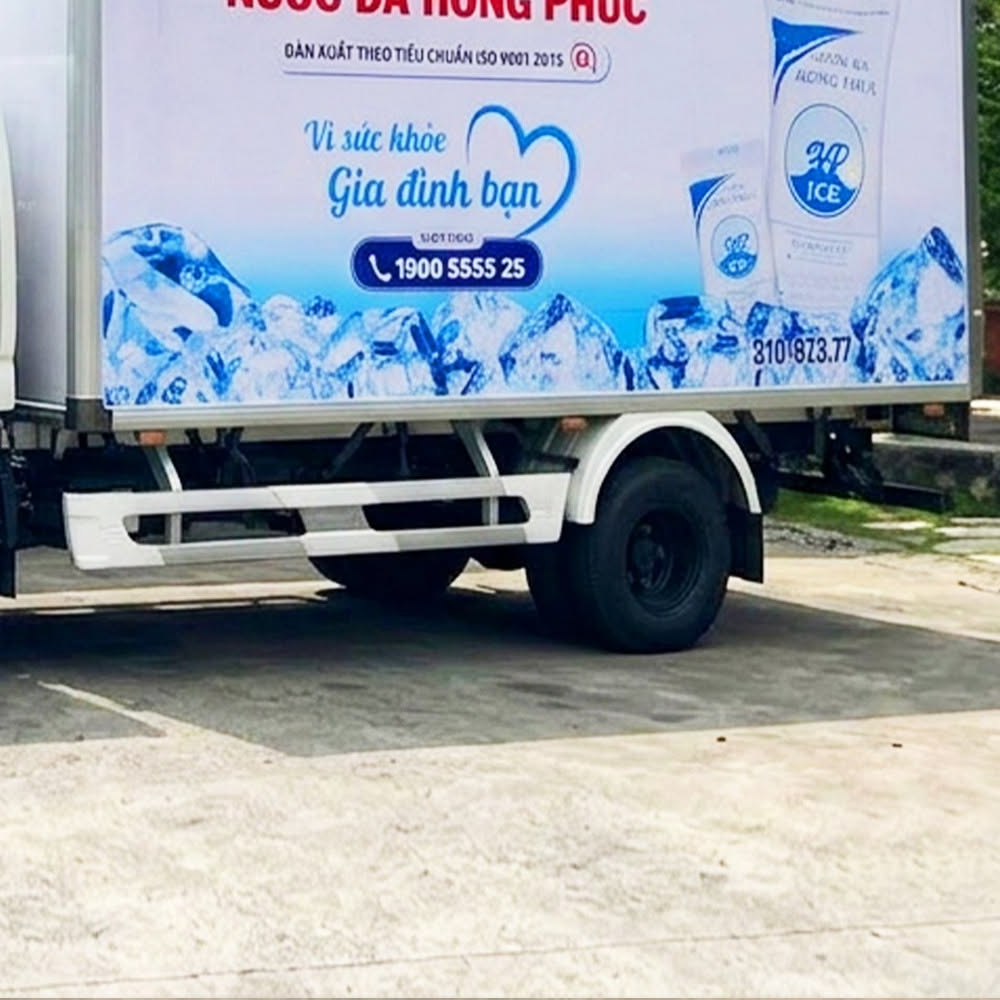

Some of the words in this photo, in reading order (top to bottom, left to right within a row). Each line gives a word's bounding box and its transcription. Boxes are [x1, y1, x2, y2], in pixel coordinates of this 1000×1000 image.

[328, 165, 387, 219] Gia
[480, 169, 542, 220] bạn
[806, 180, 842, 204] ICE
[395, 257, 444, 280] 1900
[447, 257, 497, 280] 5555
[500, 257, 527, 279] 25
